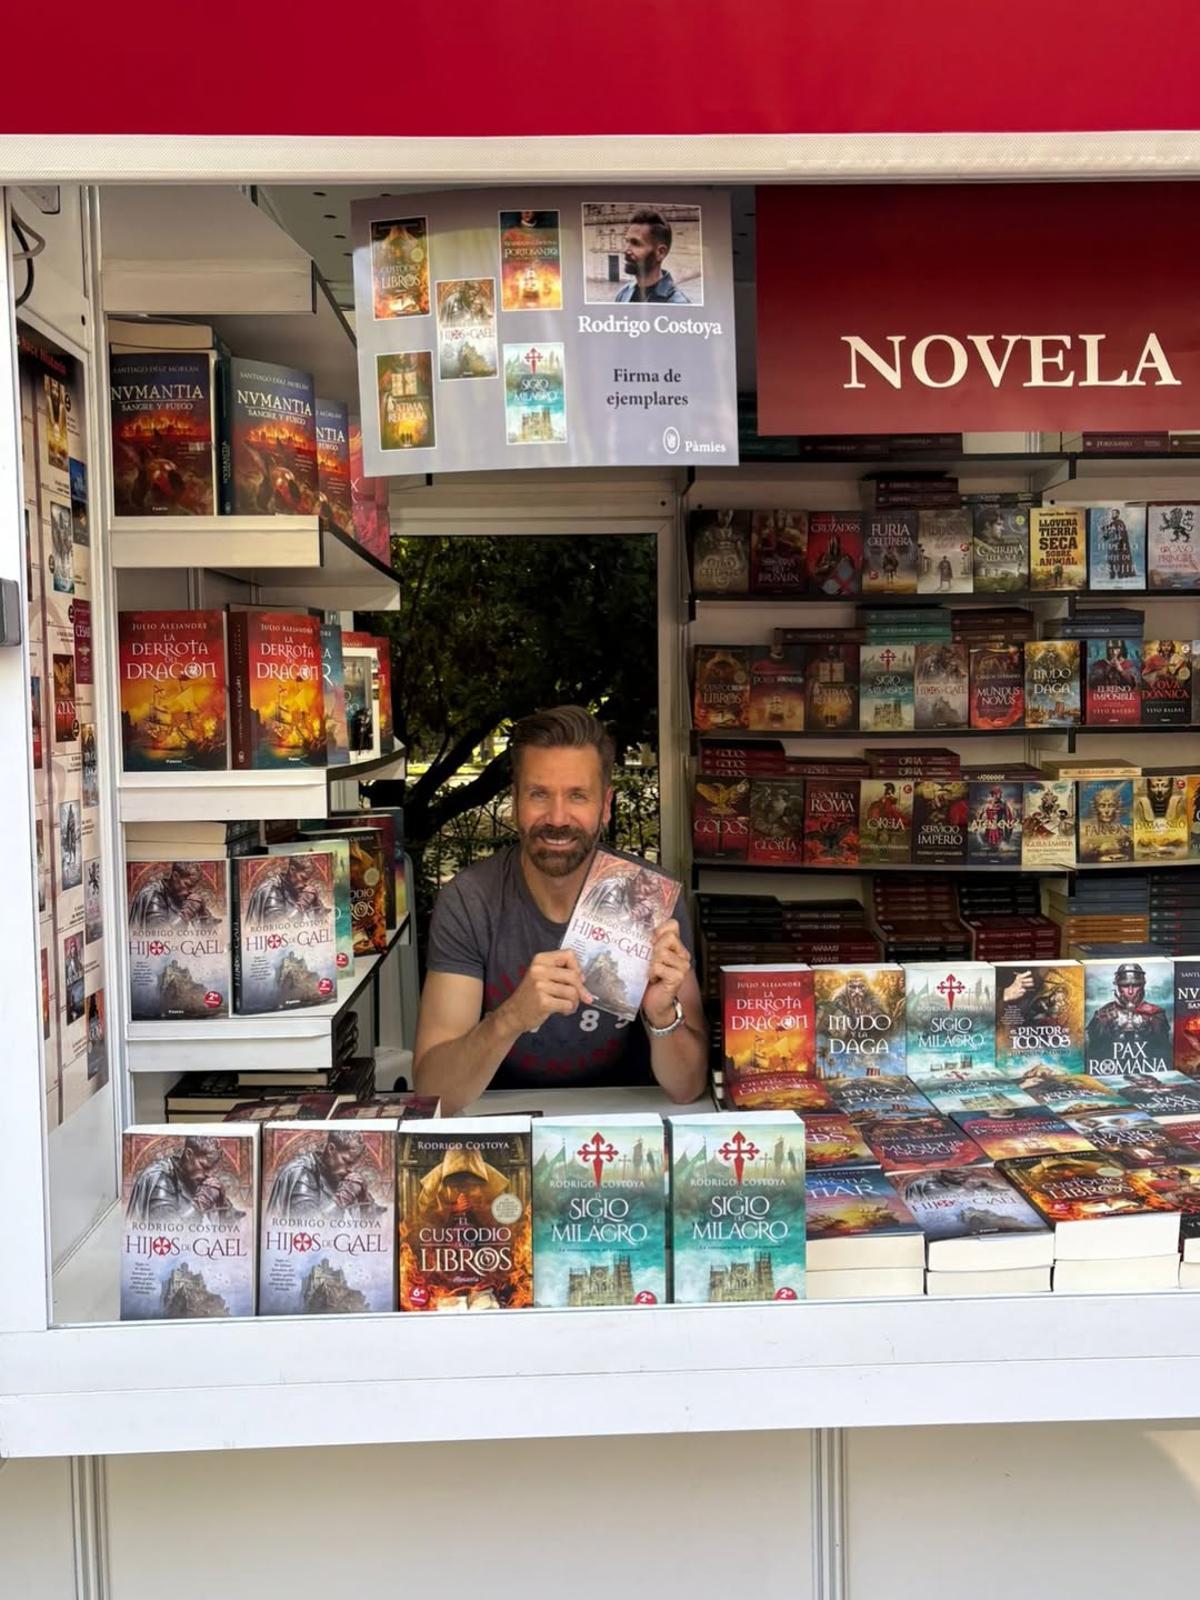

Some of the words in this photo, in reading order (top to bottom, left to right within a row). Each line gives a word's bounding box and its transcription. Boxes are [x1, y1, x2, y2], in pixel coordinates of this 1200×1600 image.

[577, 315, 650, 338] Rodrigo
[653, 317, 722, 339] Costoya
[841, 333, 1182, 389] NOVELA
[613, 368, 660, 383] Firma
[663, 367, 681, 383] de
[111, 384, 204, 400] NVMANTIA
[606, 392, 688, 408] ejemplares
[122, 402, 152, 411] SANGRE
[157, 402, 162, 410] Y
[165, 402, 193, 411] FUEGO
[237, 390, 312, 416] NVMANTIA
[248, 408, 277, 420] SANGRE
[286, 415, 306, 425] FUEGO
[316, 427, 345, 443] NTIA
[871, 523, 910, 537] FURIA
[1039, 527, 1078, 536] TIERRA
[1039, 537, 1078, 550] SECA
[1046, 550, 1071, 558] SOBRE
[133, 623, 157, 631] JULIO
[261, 624, 280, 632] JULIO
[163, 633, 175, 641] LA
[284, 636, 293, 644] LA
[132, 640, 208, 657] DERROTA
[261, 643, 314, 659] DERROTA
[127, 656, 217, 682] DRAGÓN
[257, 659, 319, 682] DRAGÓN
[977, 686, 1020, 697] MUNDUS
[982, 695, 1016, 705] NOVUS
[811, 799, 855, 813] ROMA
[694, 820, 749, 834] GODOS
[755, 840, 797, 851] GLORIA
[917, 834, 963, 845] IMPERIO
[350, 888, 374, 899] ODIO
[133, 929, 174, 937] RODRIGO
[177, 929, 218, 937] COSTOYA
[250, 922, 290, 932] RODRIGO
[293, 919, 328, 929] COSTOYA
[572, 918, 611, 945] HIJOS
[246, 934, 288, 953] HIJOS
[297, 928, 334, 948] GAEL
[129, 940, 172, 958] HIJOS
[180, 940, 225, 958] GAEL
[736, 995, 802, 1012] DERROTA
[731, 1010, 809, 1032] DRAGÓN
[828, 1014, 891, 1031] MUDO
[930, 1016, 972, 1034] SIGLO
[1018, 1026, 1061, 1036] PINTOR
[829, 1038, 889, 1054] DAGA
[918, 1033, 984, 1050] MILAGRO
[1113, 1041, 1148, 1060] PAX
[1089, 1058, 1168, 1075] ROMANA
[418, 1141, 462, 1150] RODRIGO
[465, 1141, 510, 1149] COSTOYA
[549, 1180, 594, 1188] RODRIGO
[690, 1178, 736, 1186] RODRIGO
[743, 1178, 786, 1186] COSTOYA
[1042, 1177, 1123, 1189] CUSTODIO
[1050, 1184, 1134, 1200] LIBROS
[569, 1198, 629, 1222] SIGLO
[710, 1195, 770, 1220] SIGLO
[132, 1222, 184, 1233] RODRIGO
[188, 1223, 240, 1233] COSTOYA
[272, 1217, 325, 1228] RODRIGO
[329, 1219, 381, 1228] COSTOYA
[458, 1217, 468, 1225] EL
[419, 1227, 511, 1243] CUSTODIO
[551, 1223, 648, 1246] MILAGRO
[692, 1220, 788, 1244] MILAGRO
[126, 1235, 181, 1260] HIJOS
[192, 1238, 248, 1260] GAEL
[266, 1231, 322, 1255] HIJOS
[333, 1233, 388, 1256] GAEL
[421, 1247, 513, 1276] LIBROS
